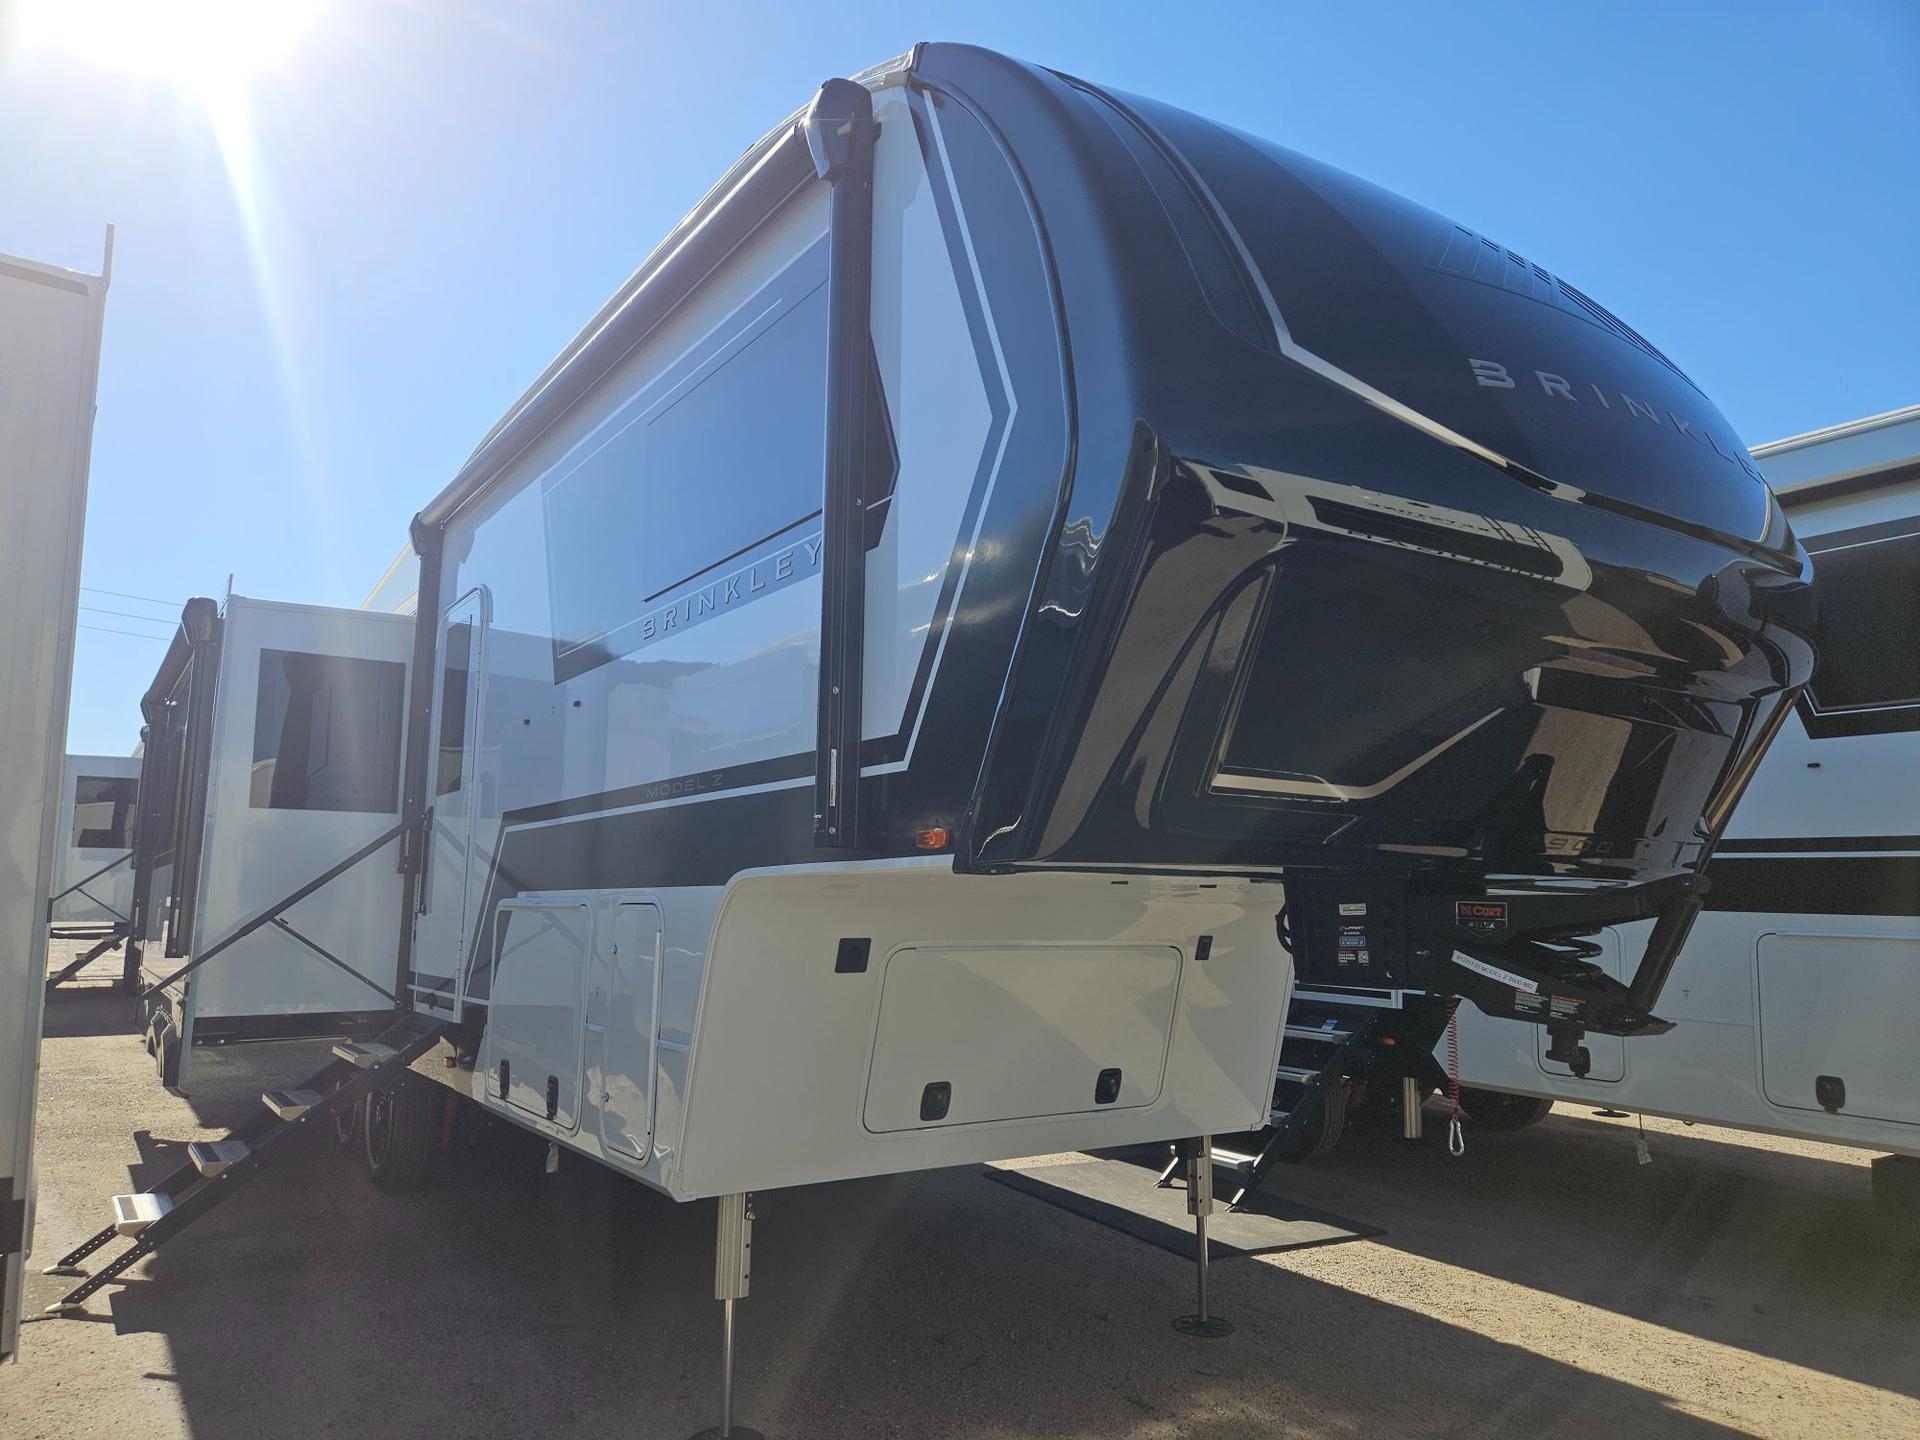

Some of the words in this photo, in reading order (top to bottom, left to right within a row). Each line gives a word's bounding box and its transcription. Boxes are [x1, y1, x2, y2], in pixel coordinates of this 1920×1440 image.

[1468, 358, 1764, 486] BRINKLE
[642, 538, 822, 640] BRINKLEY
[646, 777, 705, 799] MODEL
[711, 774, 723, 787] Z
